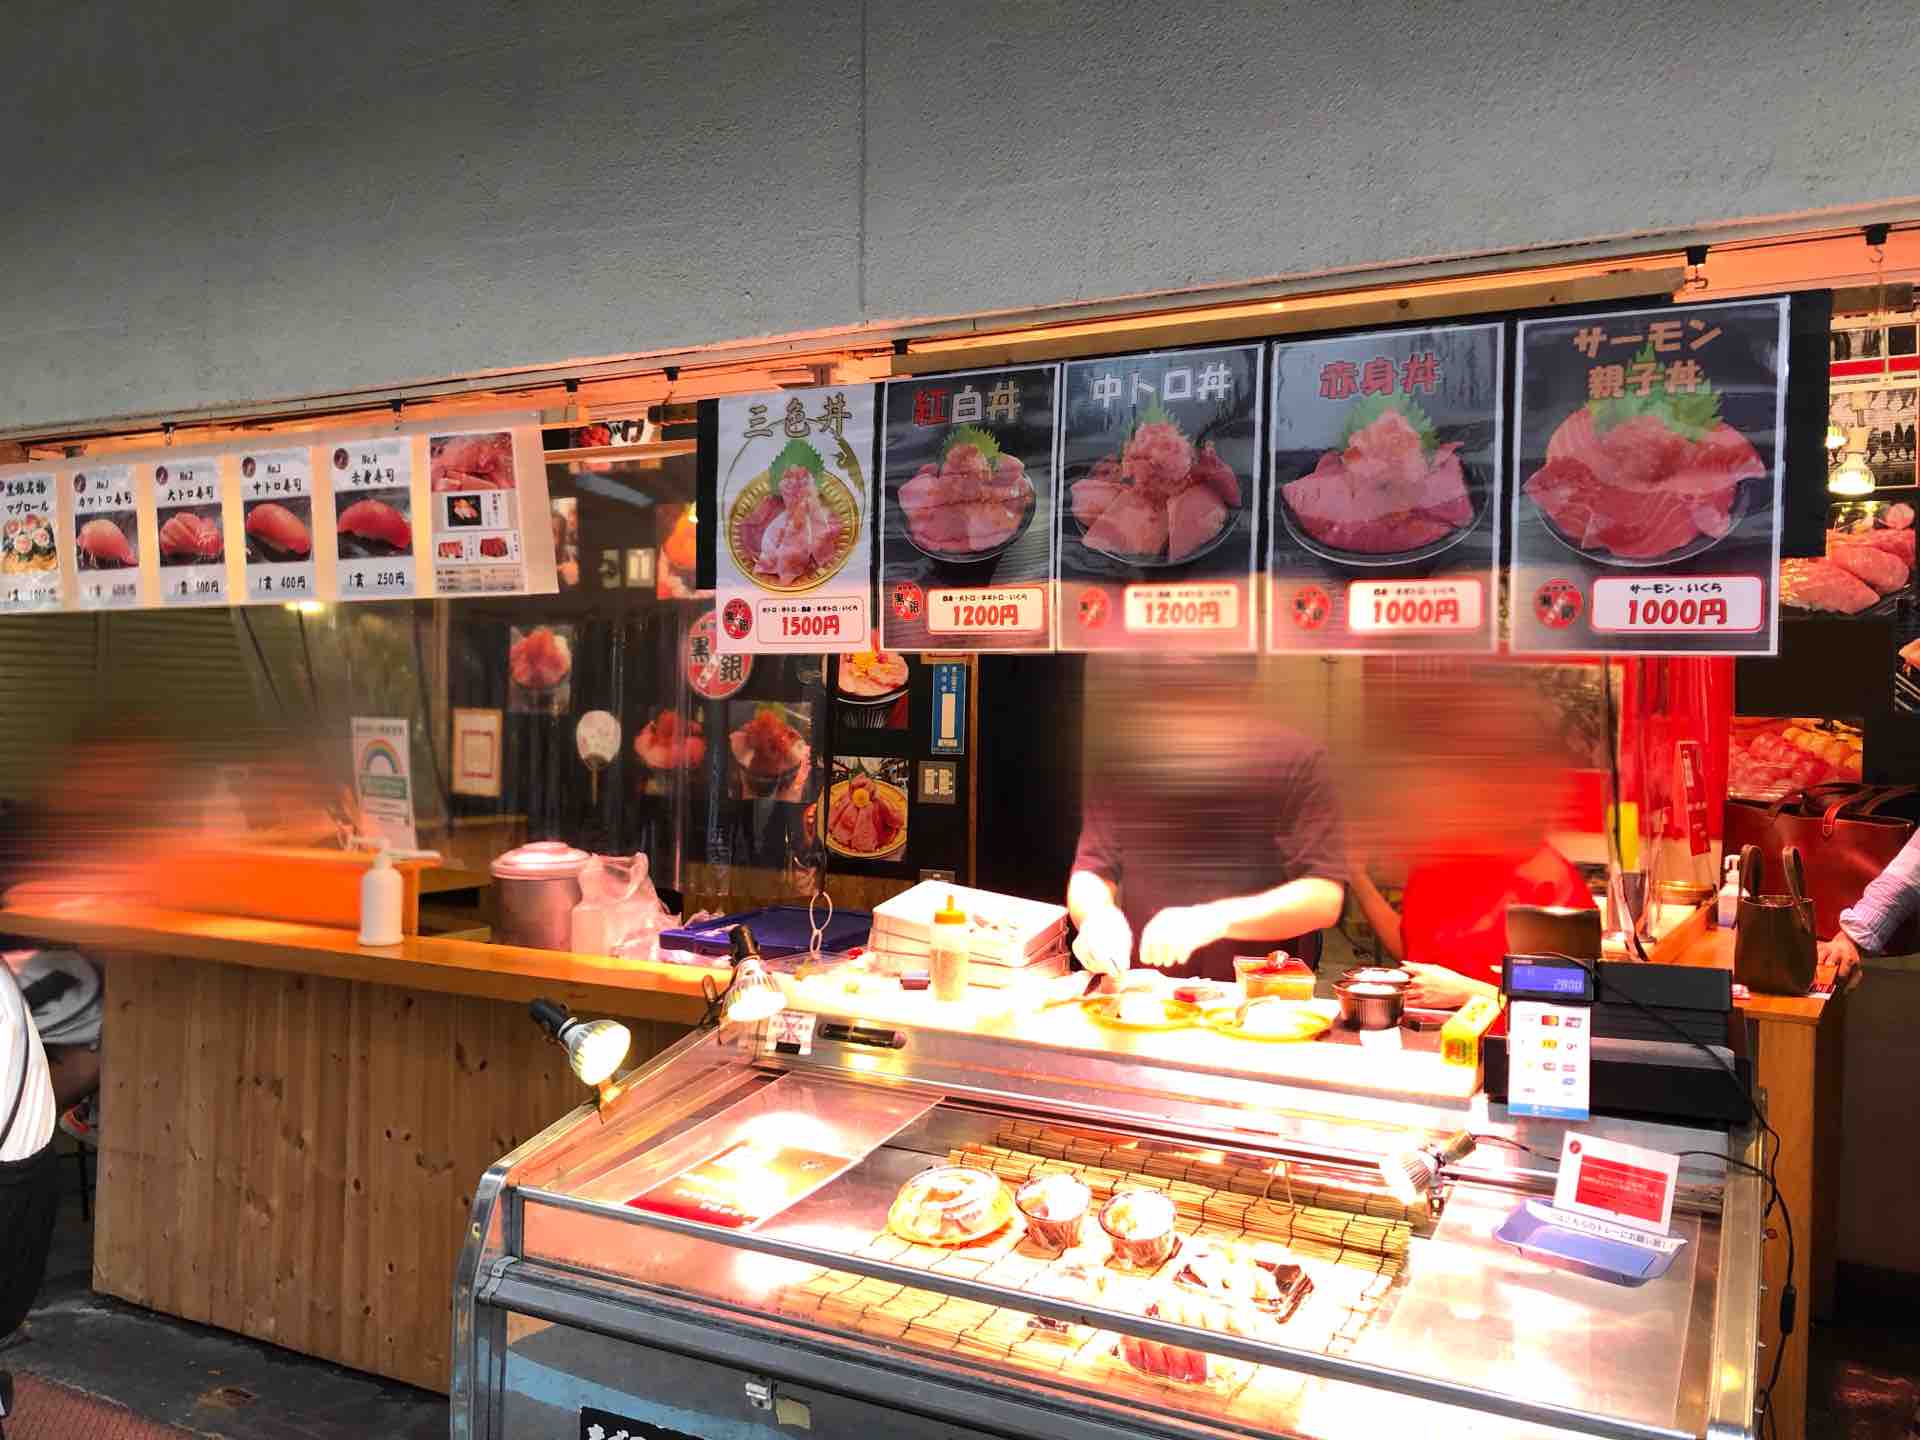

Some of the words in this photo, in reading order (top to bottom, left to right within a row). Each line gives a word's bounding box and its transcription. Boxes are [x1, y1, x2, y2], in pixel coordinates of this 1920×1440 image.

[1573, 319, 1723, 358] サーモン
[1090, 362, 1234, 408] 中トロ丼
[1318, 351, 1442, 399] 赤身丼
[1587, 359, 1700, 400] 親子丼
[743, 391, 853, 440] 三色丼
[912, 381, 1020, 425] 紅白丼
[281, 575, 306, 590] 400円
[377, 571, 405, 586] 250円
[953, 604, 1018, 626] 1200円
[1145, 601, 1220, 624] 1200円
[1374, 599, 1459, 623] 1000円
[1628, 598, 1727, 625] 1000円
[782, 615, 839, 636] 1500円
